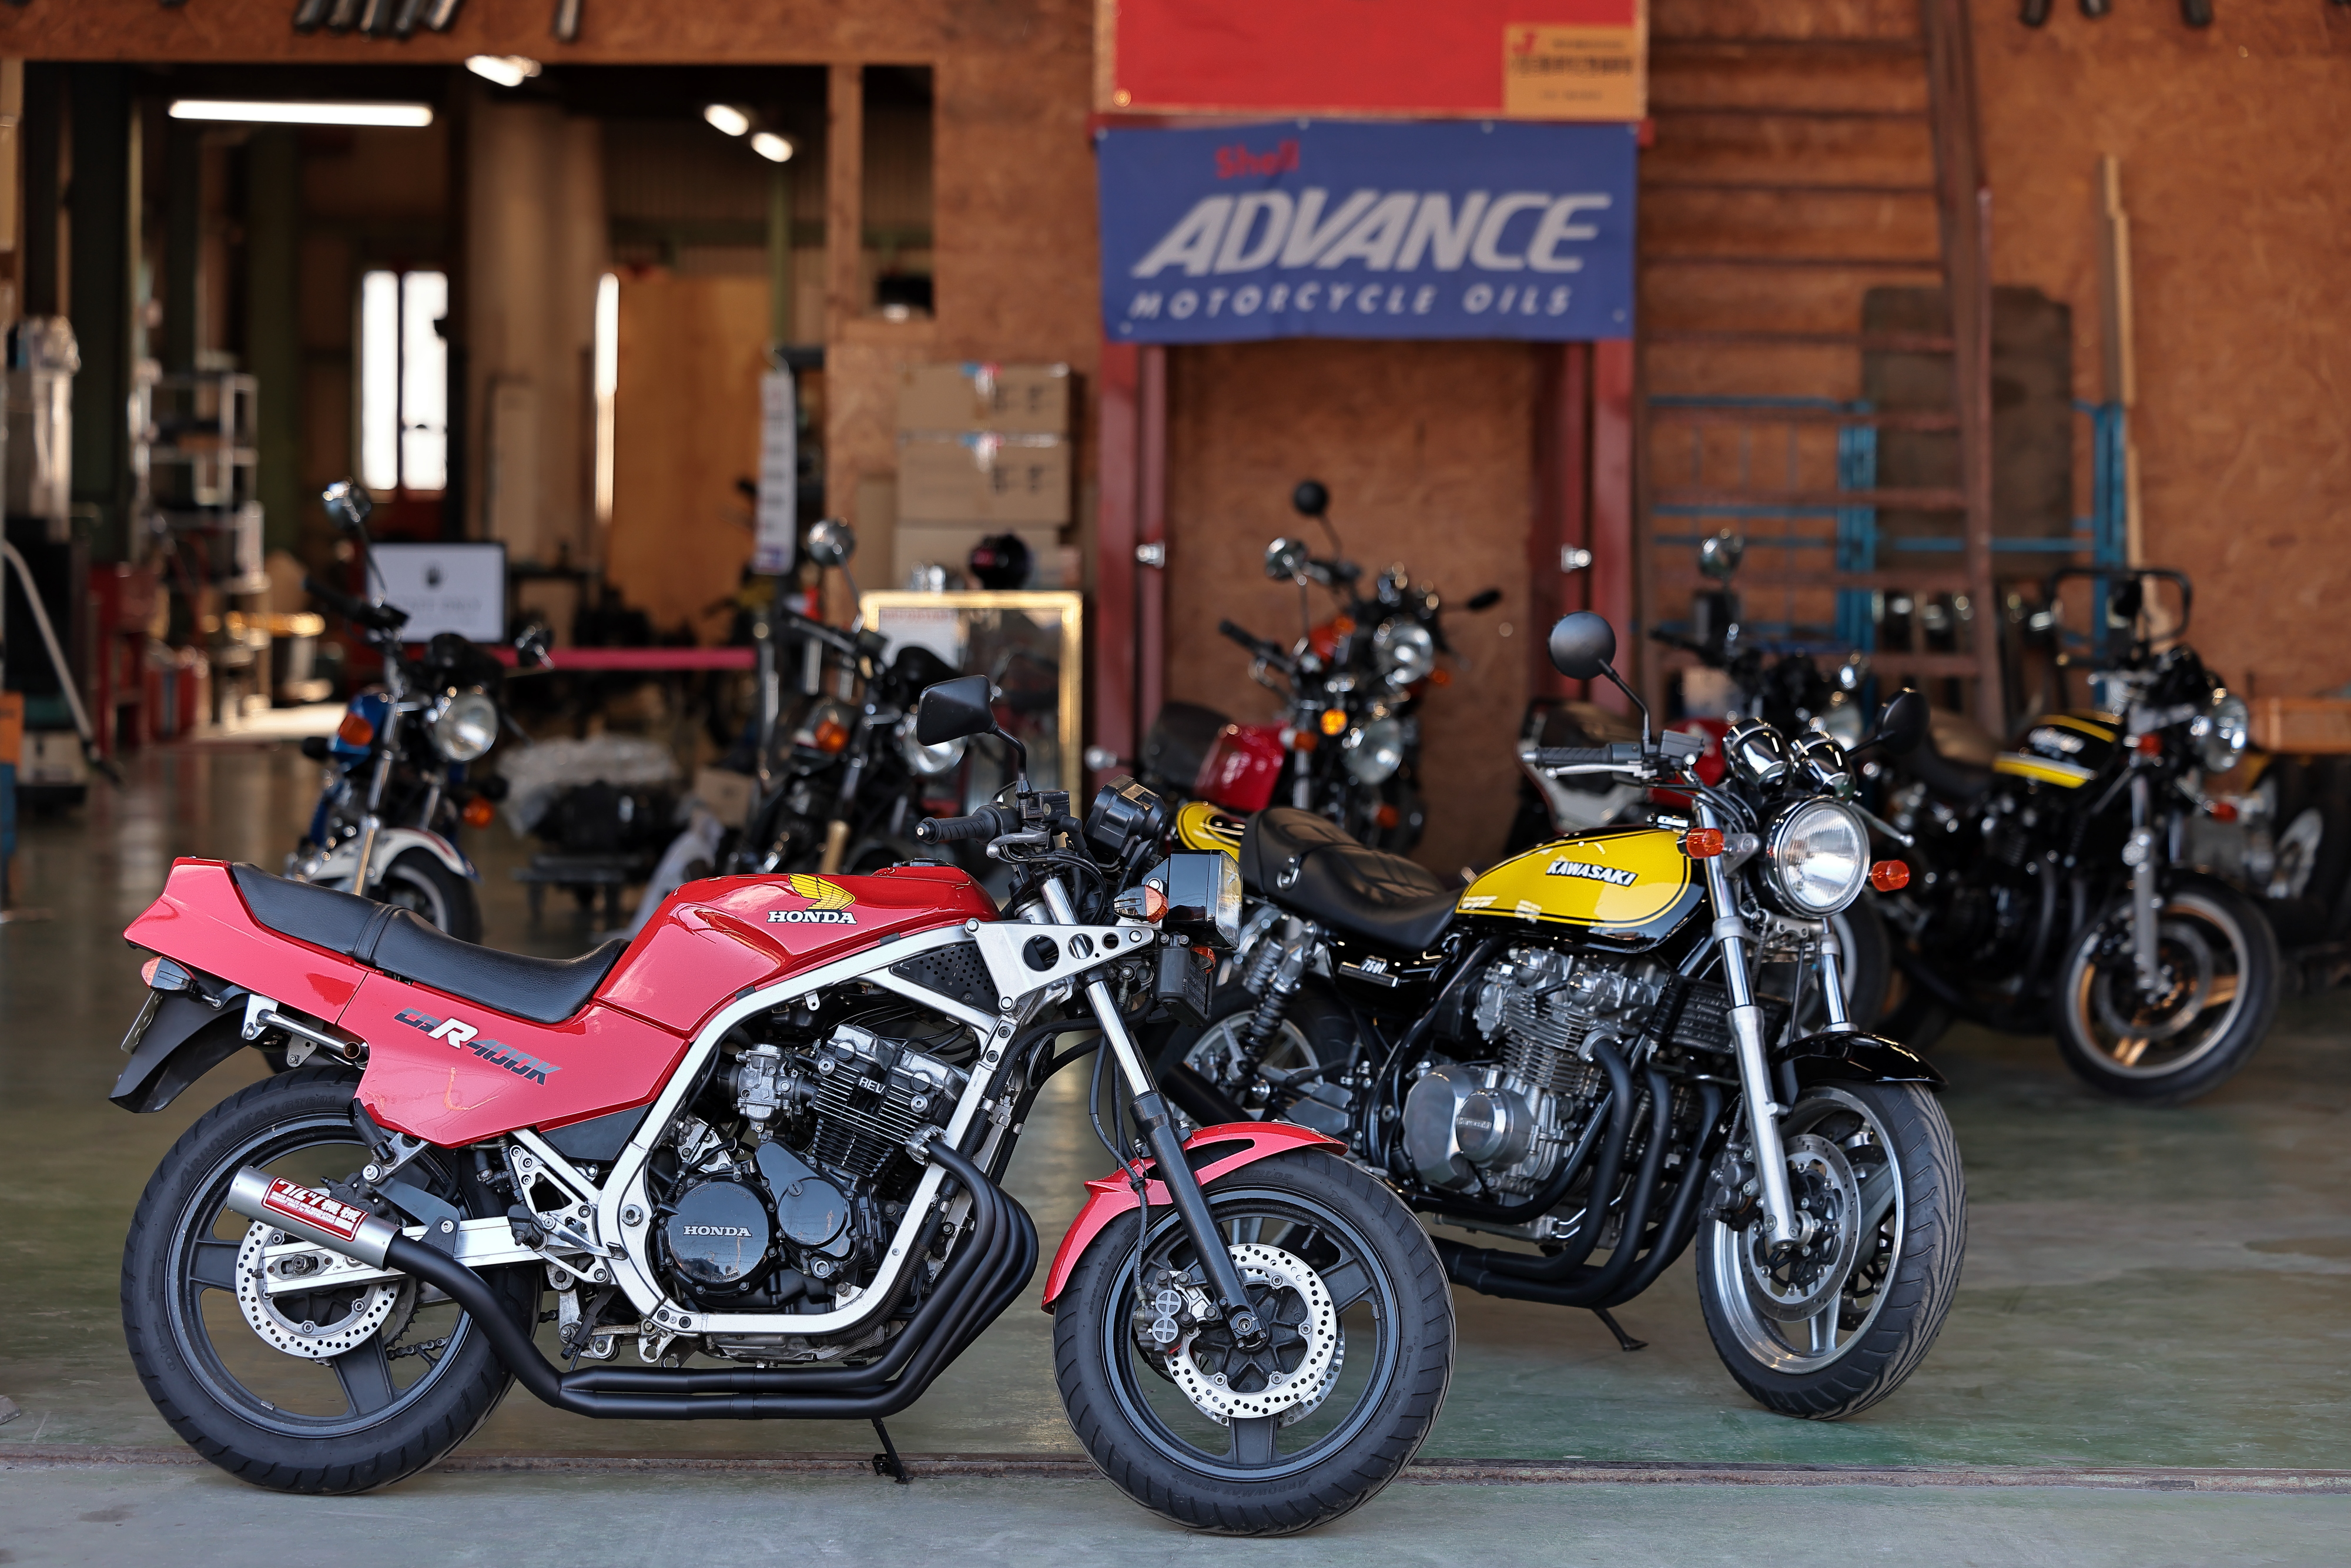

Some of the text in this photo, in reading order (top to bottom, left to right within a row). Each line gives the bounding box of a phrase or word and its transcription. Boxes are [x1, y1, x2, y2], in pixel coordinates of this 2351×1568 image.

[1215, 140, 1300, 179] Shell
[1130, 187, 1612, 279] ADVANCE
[1128, 283, 1572, 321] MOTORCYCLE OILS
[1546, 860, 1638, 887] KAWASAKI
[767, 910, 858, 924] HONDA
[858, 1076, 886, 1094] REV
[283, 1095, 336, 1111] GT601
[1234, 1170, 1294, 1181] DUNLOP
[683, 1225, 752, 1237] HONDA
[1120, 1218, 1138, 1236] TUBELESS
